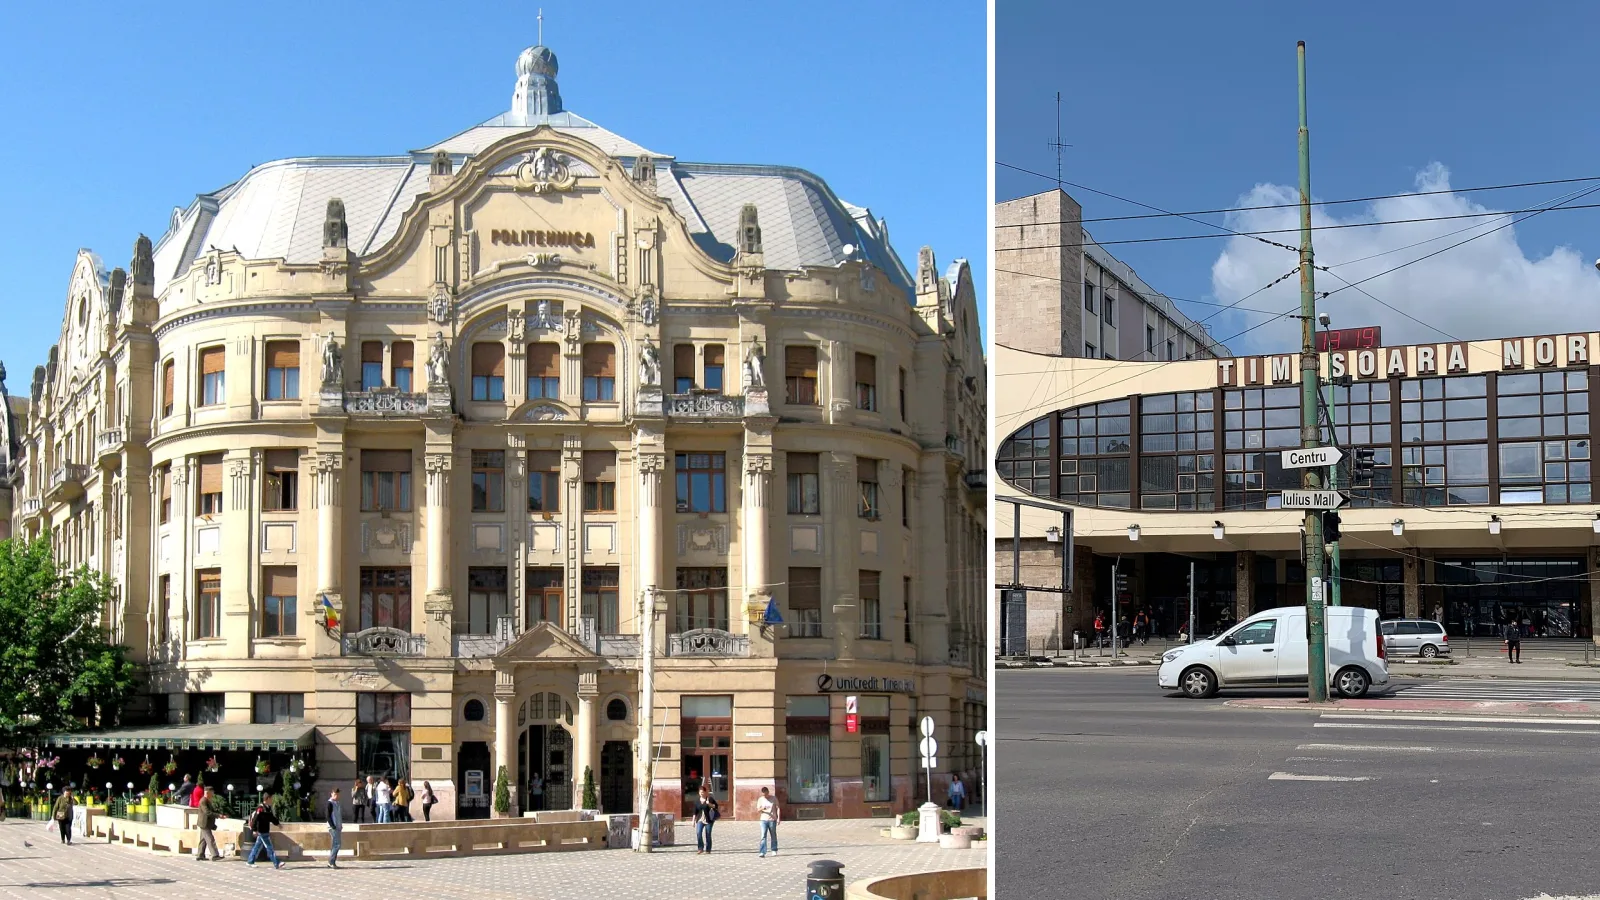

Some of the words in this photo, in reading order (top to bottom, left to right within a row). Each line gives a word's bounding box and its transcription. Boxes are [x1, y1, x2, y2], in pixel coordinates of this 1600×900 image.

[491, 229, 595, 248] POLITEHNICA
[1219, 344, 1467, 385] TIMSOARA
[1290, 452, 1326, 465] Centru
[1283, 492, 1311, 506] Iulius
[1313, 493, 1334, 506] Mall
[836, 676, 879, 690] UniCredit
